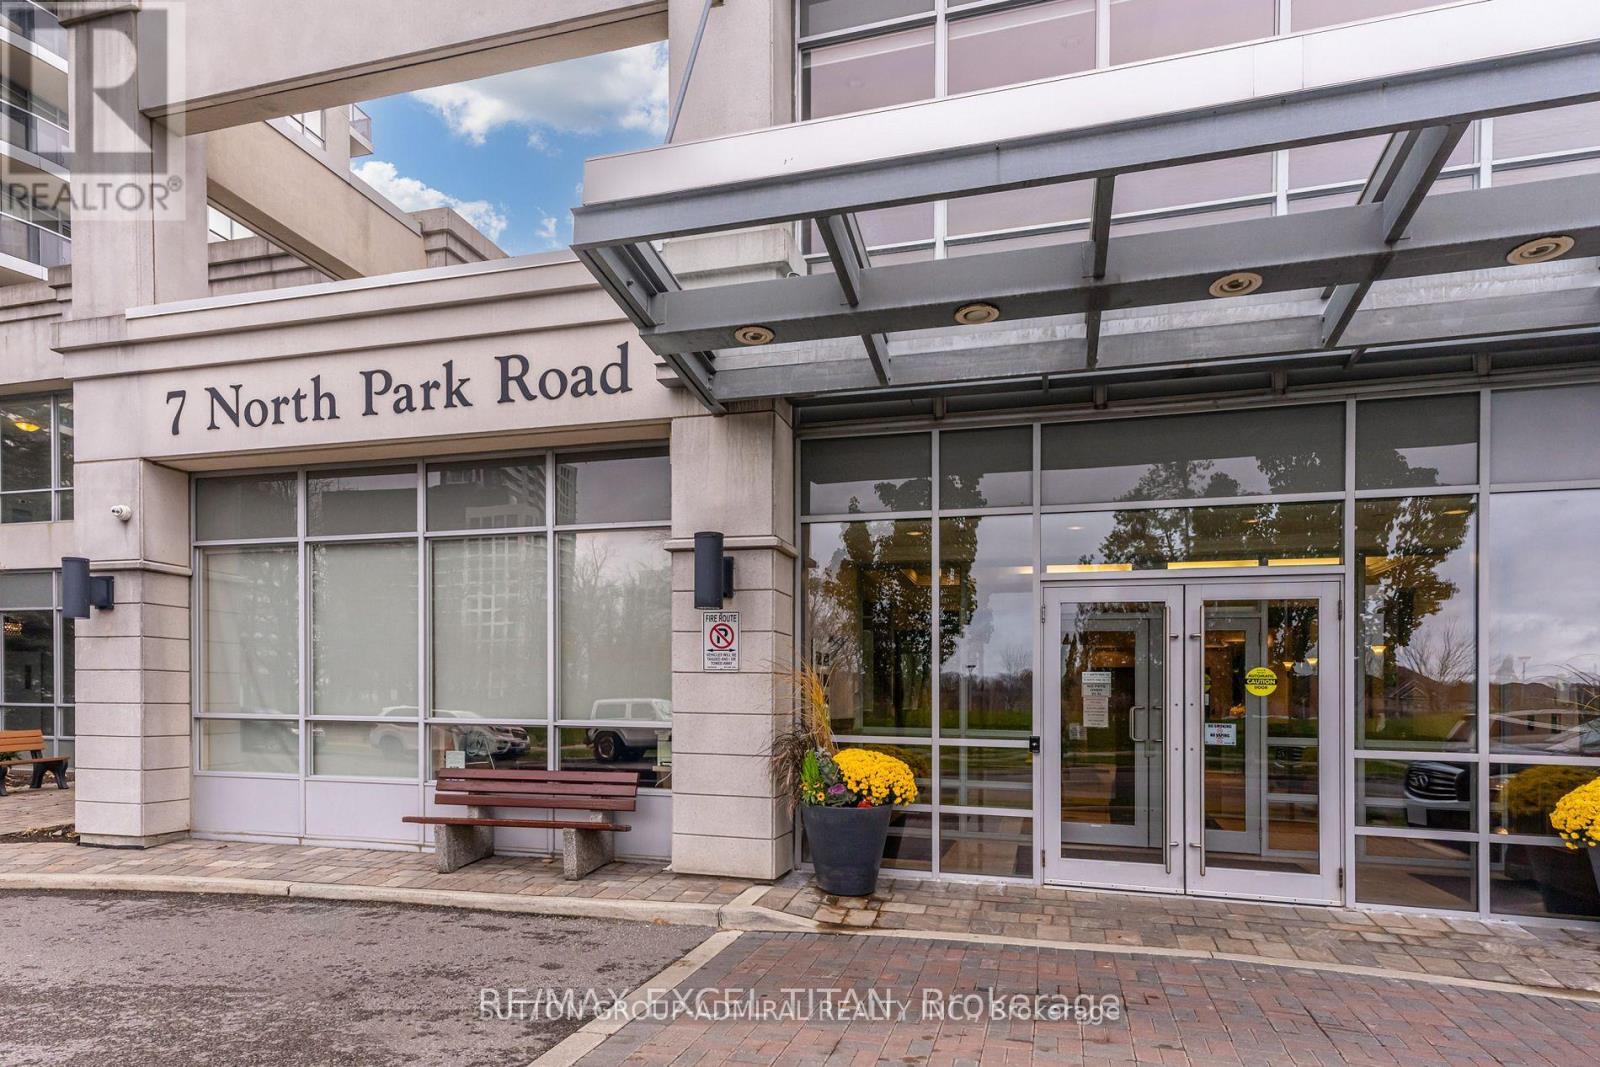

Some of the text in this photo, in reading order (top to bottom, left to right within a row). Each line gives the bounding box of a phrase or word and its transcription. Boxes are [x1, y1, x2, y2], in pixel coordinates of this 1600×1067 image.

[165, 341, 633, 436] 7 North Park Road
[705, 614, 737, 623] FIRE ROUTE
